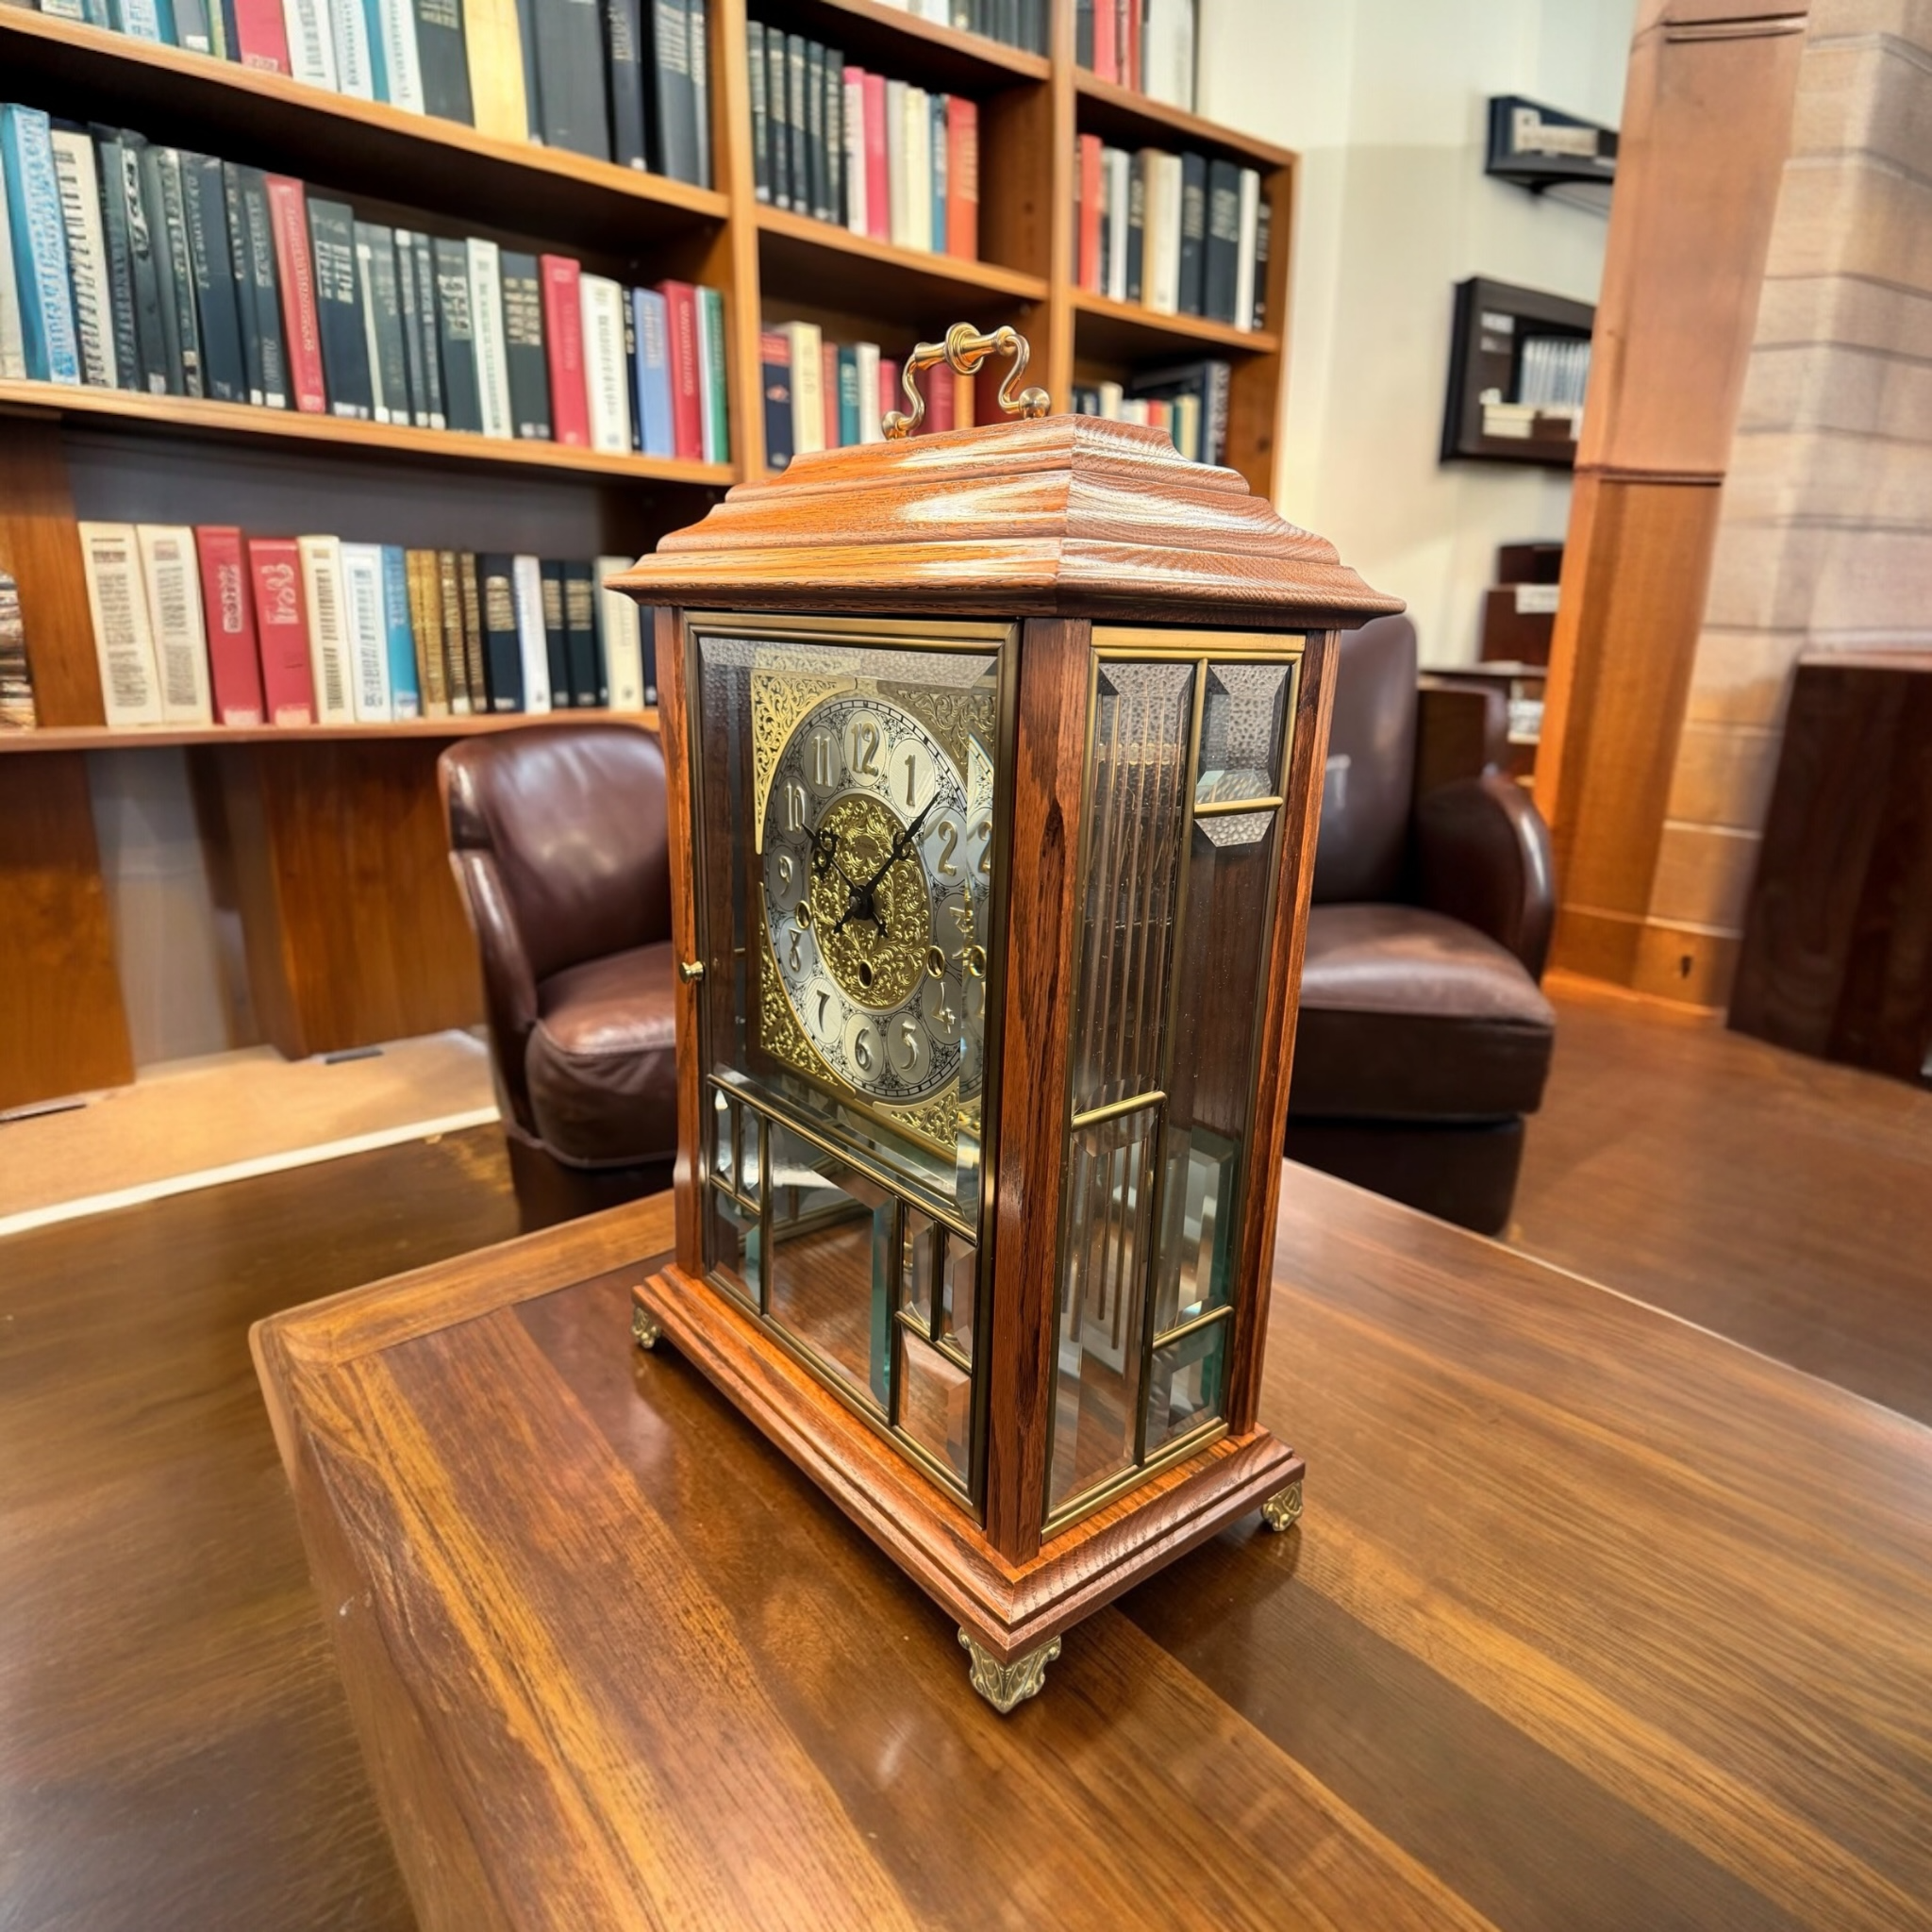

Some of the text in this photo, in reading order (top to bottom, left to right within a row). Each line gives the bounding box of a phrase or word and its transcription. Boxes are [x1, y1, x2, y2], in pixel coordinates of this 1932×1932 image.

[811, 731, 834, 788] 11
[851, 722, 880, 777] 12
[905, 755, 916, 808] 1
[784, 782, 806, 835] 10
[938, 821, 958, 876] 2
[778, 855, 794, 897] 9
[789, 927, 803, 973] 8
[817, 990, 830, 1033] 7
[931, 982, 957, 1035] 4
[855, 1026, 874, 1072] 6
[901, 1021, 921, 1073] 5
